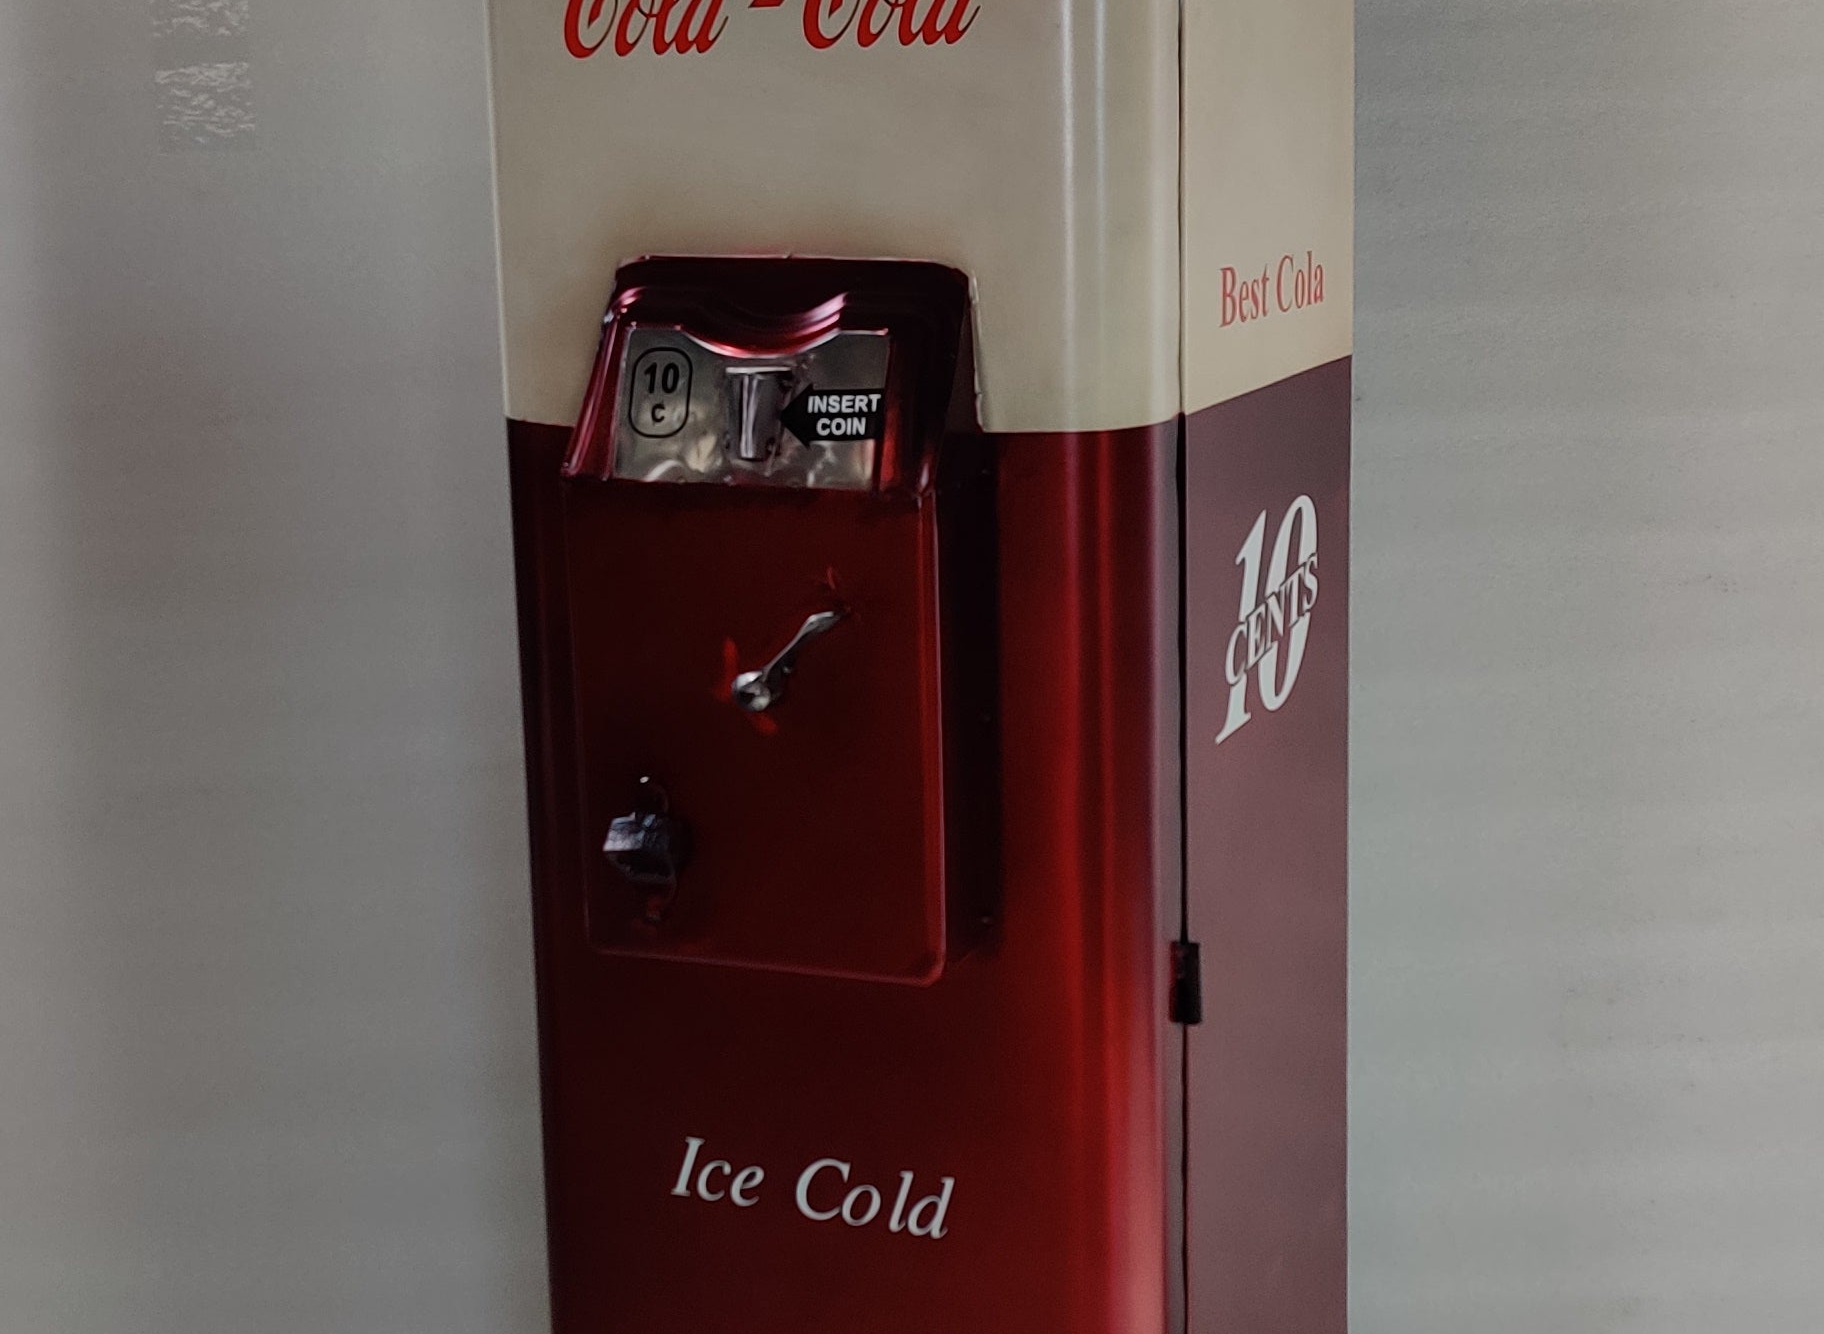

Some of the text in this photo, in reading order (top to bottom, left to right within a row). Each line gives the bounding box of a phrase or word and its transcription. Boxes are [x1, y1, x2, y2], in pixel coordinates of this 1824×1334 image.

[1219, 250, 1325, 328] Best Cola
[644, 362, 680, 395] 10
[807, 393, 882, 414] INSERT
[816, 417, 867, 437] COIN
[1214, 494, 1318, 745] 10
[1225, 553, 1319, 686] CENTS
[671, 1136, 955, 1240] Ice Cold
